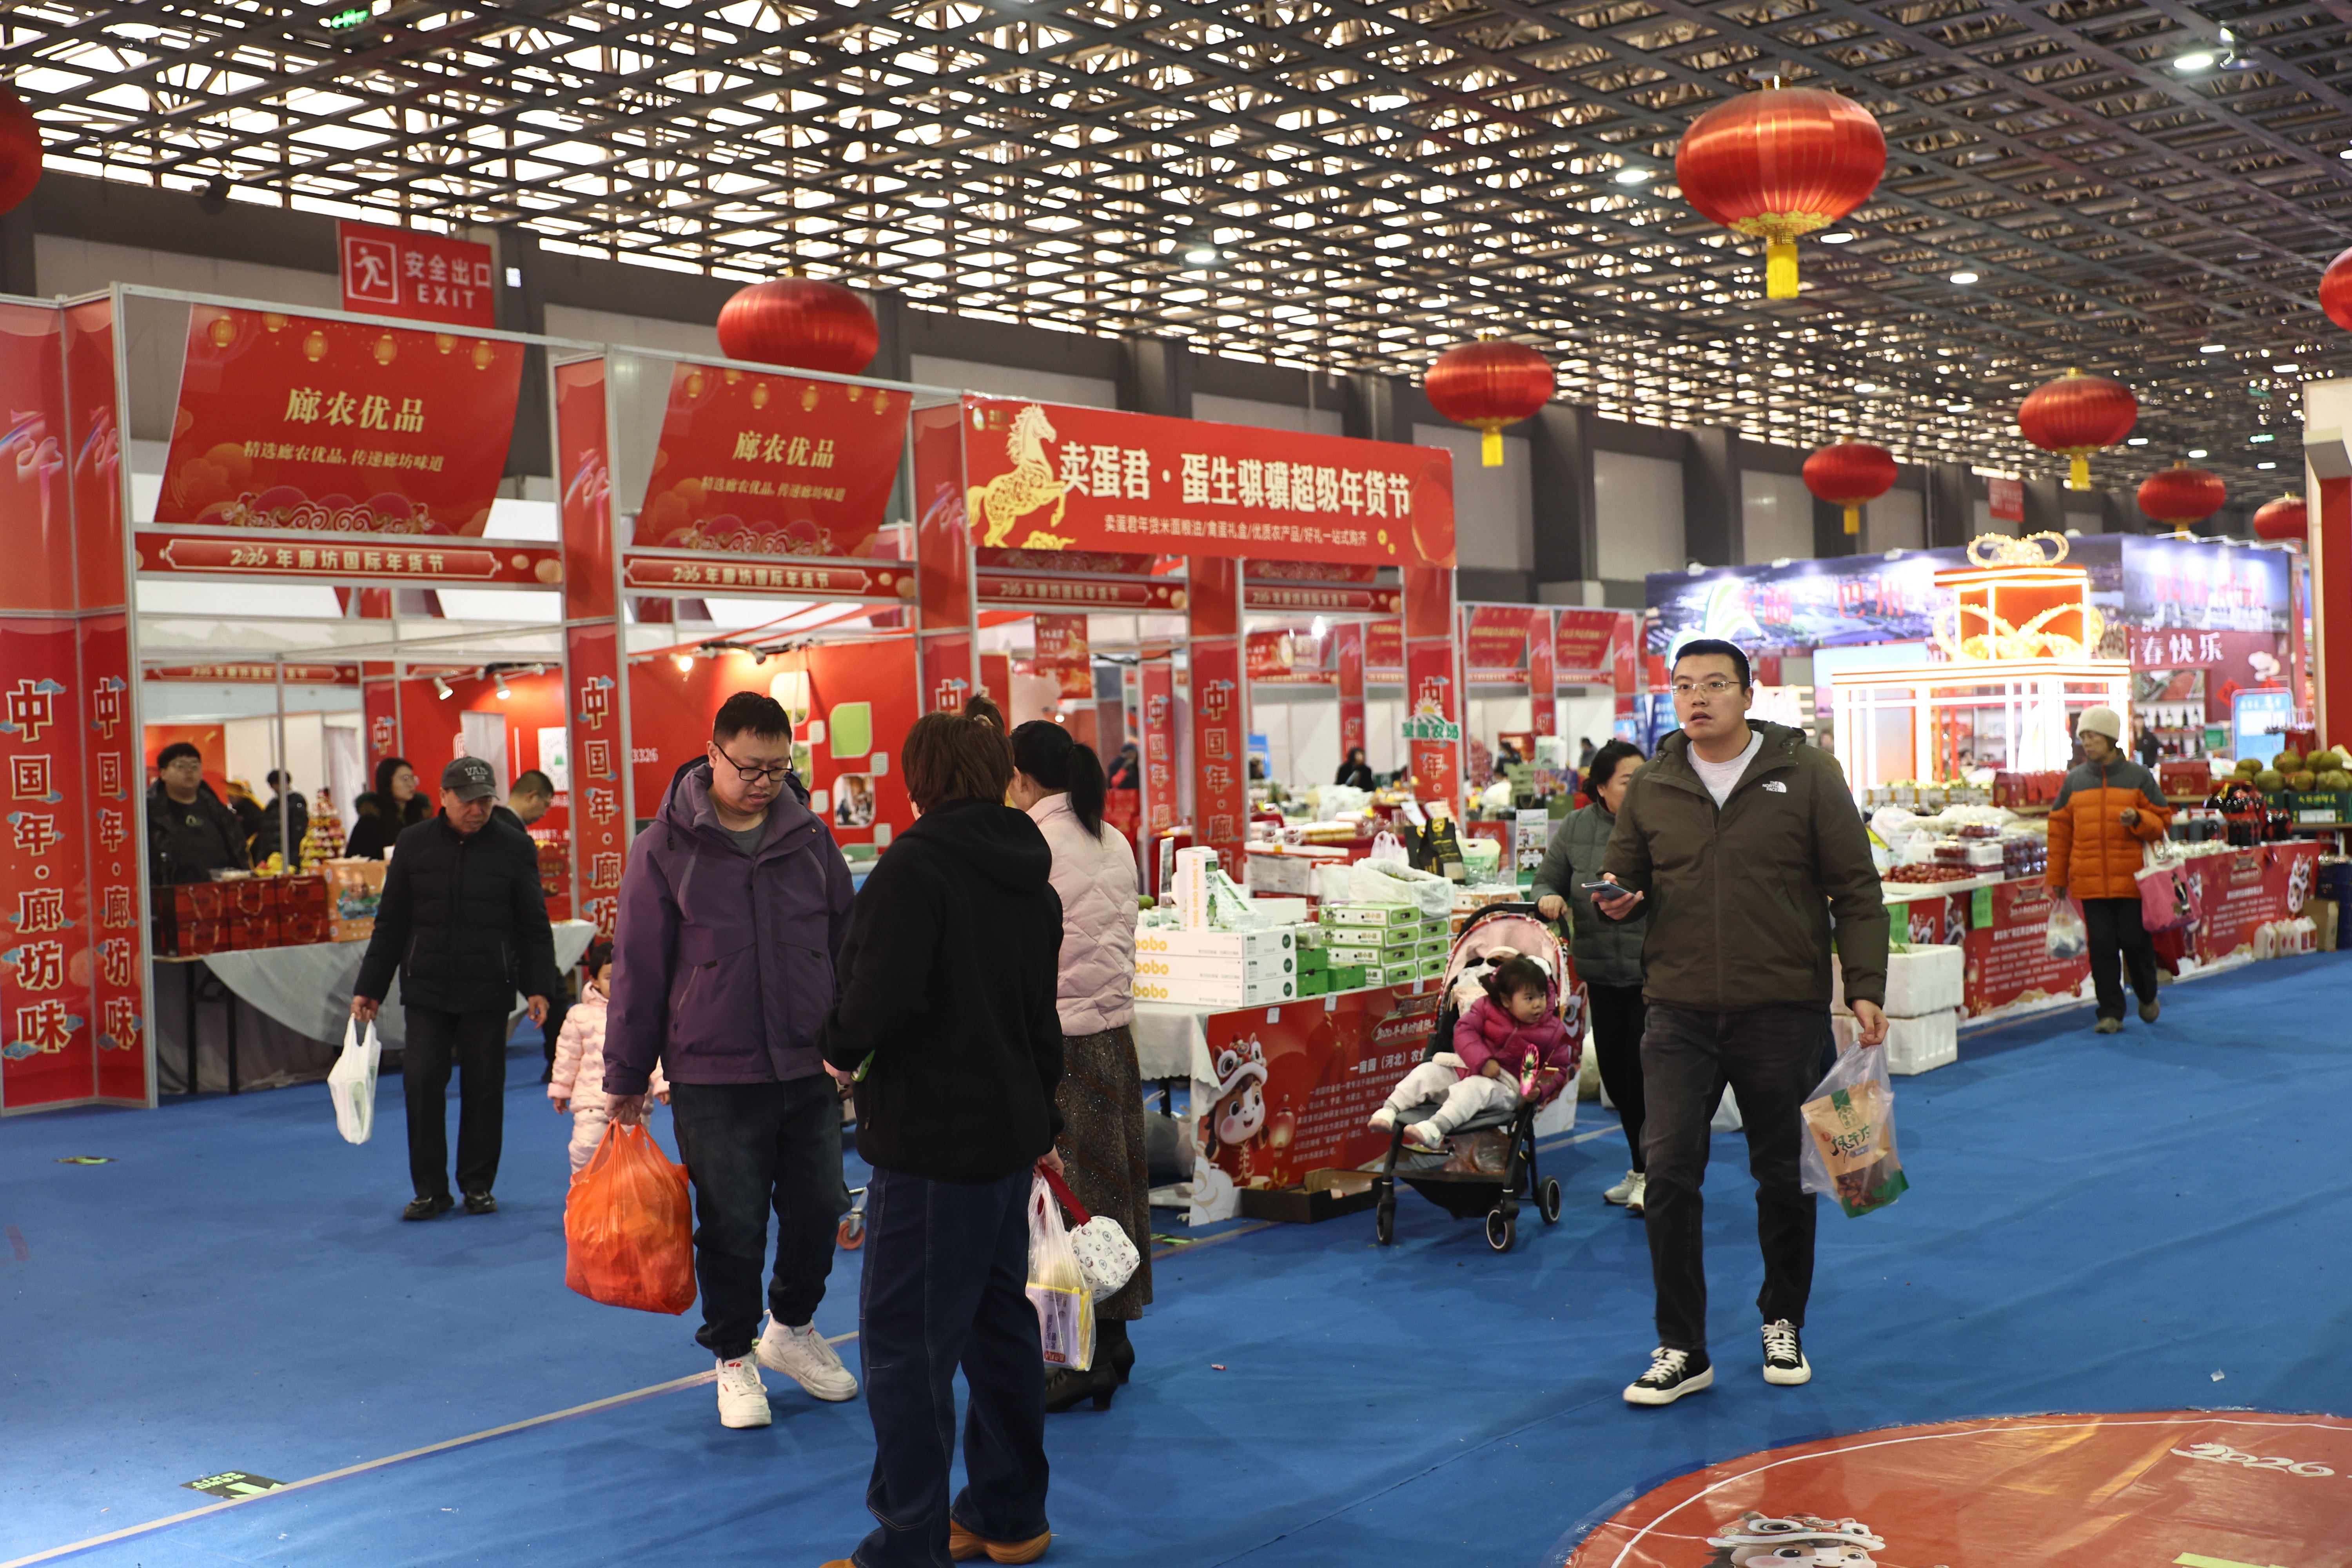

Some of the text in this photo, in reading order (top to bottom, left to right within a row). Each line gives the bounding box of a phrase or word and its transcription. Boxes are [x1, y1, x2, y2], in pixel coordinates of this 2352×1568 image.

[404, 250, 491, 288] 安全出口
[417, 283, 475, 309] EXIT
[283, 387, 425, 432] 廊农优品
[731, 430, 835, 469] 廊农优品
